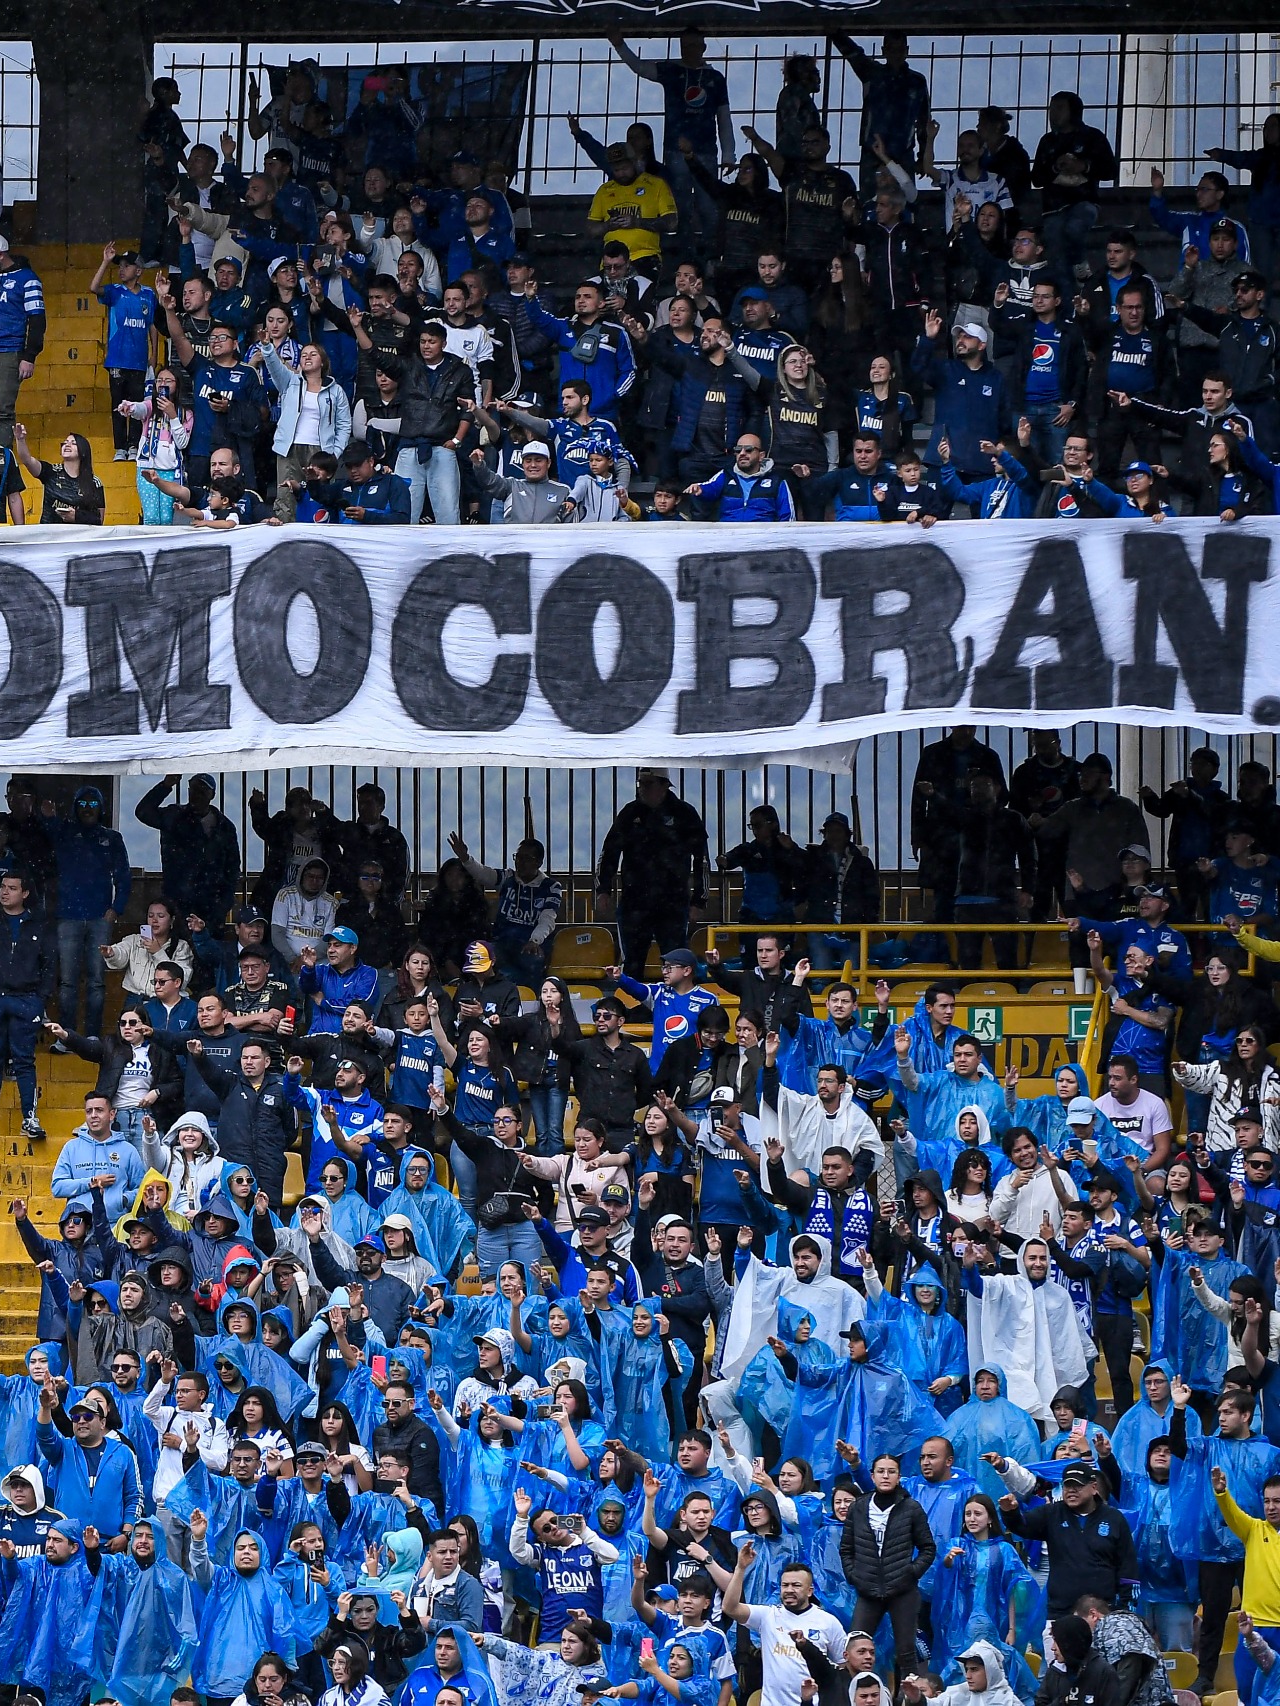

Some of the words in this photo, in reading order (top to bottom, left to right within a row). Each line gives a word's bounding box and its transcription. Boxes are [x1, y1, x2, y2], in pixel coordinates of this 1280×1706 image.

[727, 209, 759, 224] NDINA
[68, 347, 79, 360] G
[737, 343, 774, 361] ANDINA
[1111, 350, 1147, 367] ANDINA
[1031, 364, 1052, 373] pepsi
[66, 395, 77, 407] F
[780, 407, 818, 426] ANDINA
[861, 414, 883, 430] ANDI
[15, 1544, 41, 1558] DINA
[545, 1558, 556, 1573] 10
[547, 1569, 595, 1589] LEONA
